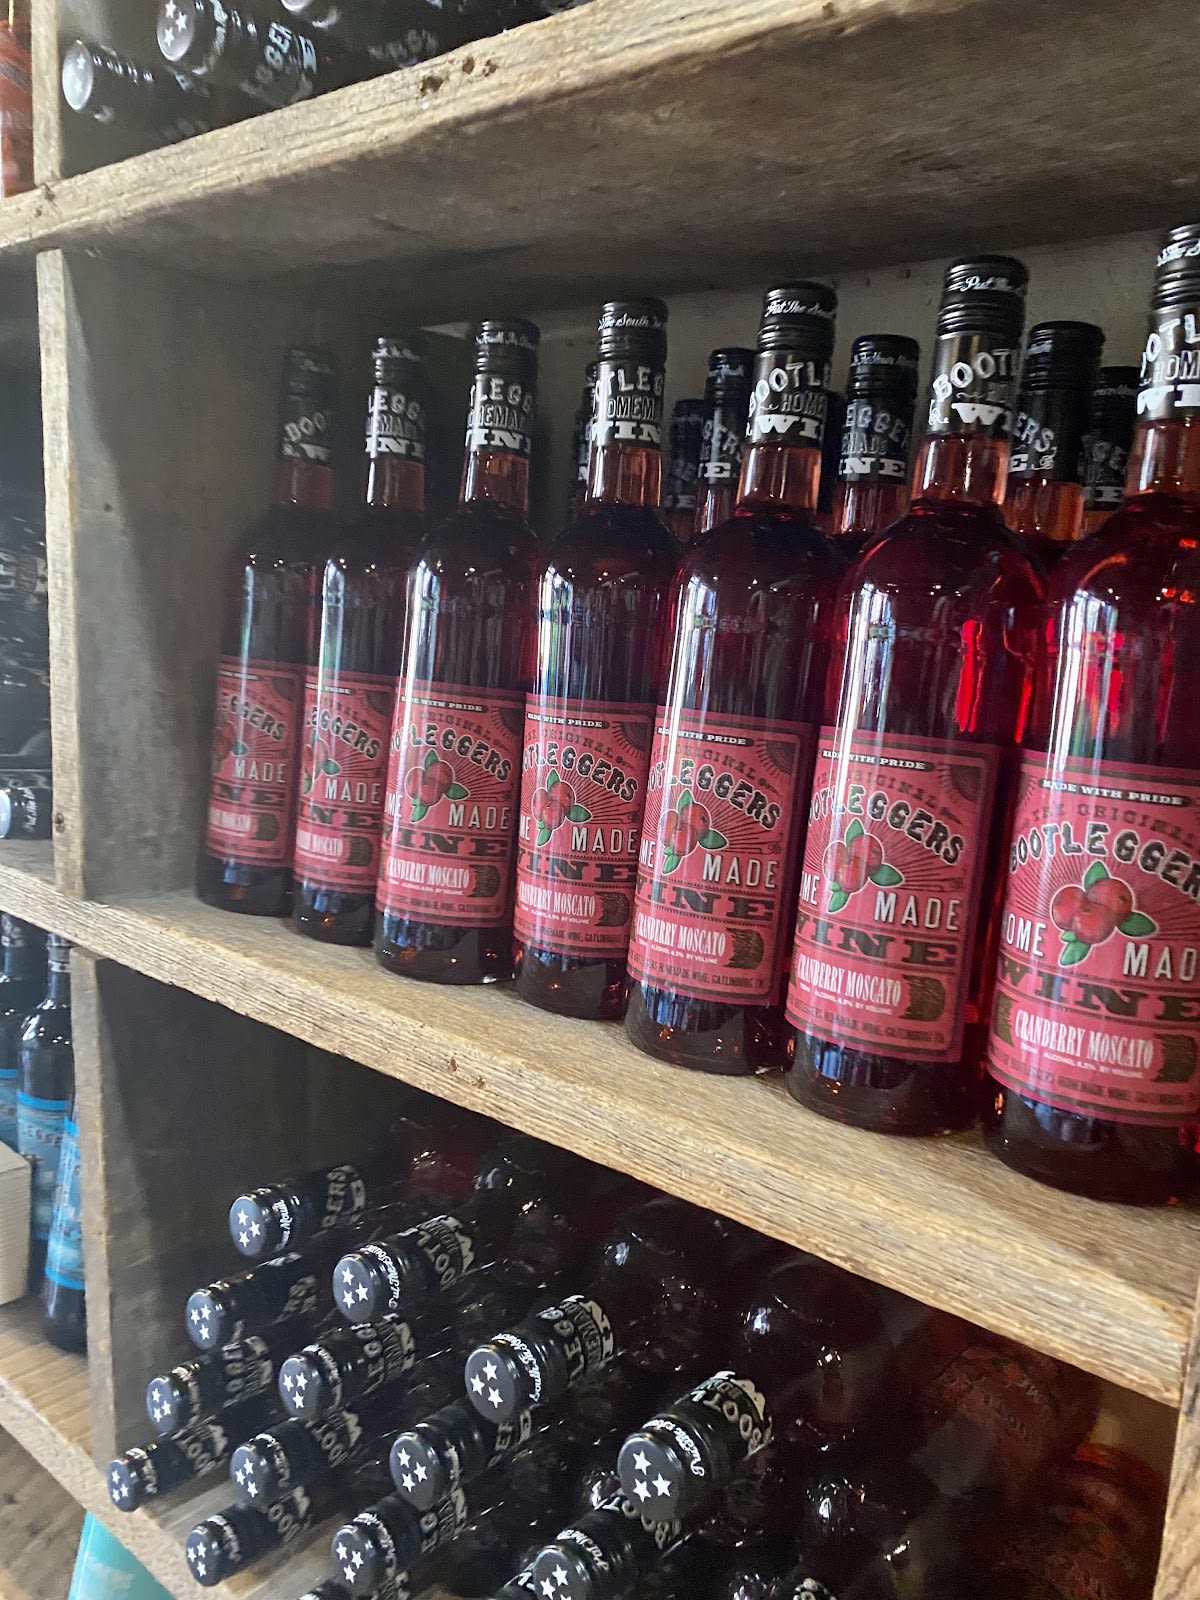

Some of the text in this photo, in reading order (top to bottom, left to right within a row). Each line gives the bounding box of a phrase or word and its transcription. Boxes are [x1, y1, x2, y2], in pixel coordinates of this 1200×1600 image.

[448, 701, 483, 713] PRIDE
[567, 719, 603, 728] PRIDE
[706, 733, 747, 745] PRIDE
[233, 758, 287, 784] MADE
[879, 757, 927, 770] PRIDE
[325, 778, 380, 805] MADE
[1080, 785, 1122, 799] WITH
[1127, 791, 1183, 806] PRIDE
[448, 802, 511, 831] MADE
[571, 825, 638, 855] MADE
[428, 864, 471, 890] MOSCATO
[702, 853, 778, 889] MADE
[553, 890, 596, 918] MOSCATO
[873, 890, 962, 931] MADE
[678, 925, 727, 959] MOSCATO
[845, 970, 902, 1007] MOSCATO
[1014, 1008, 1154, 1070] CRANBERRY MOSCATO
